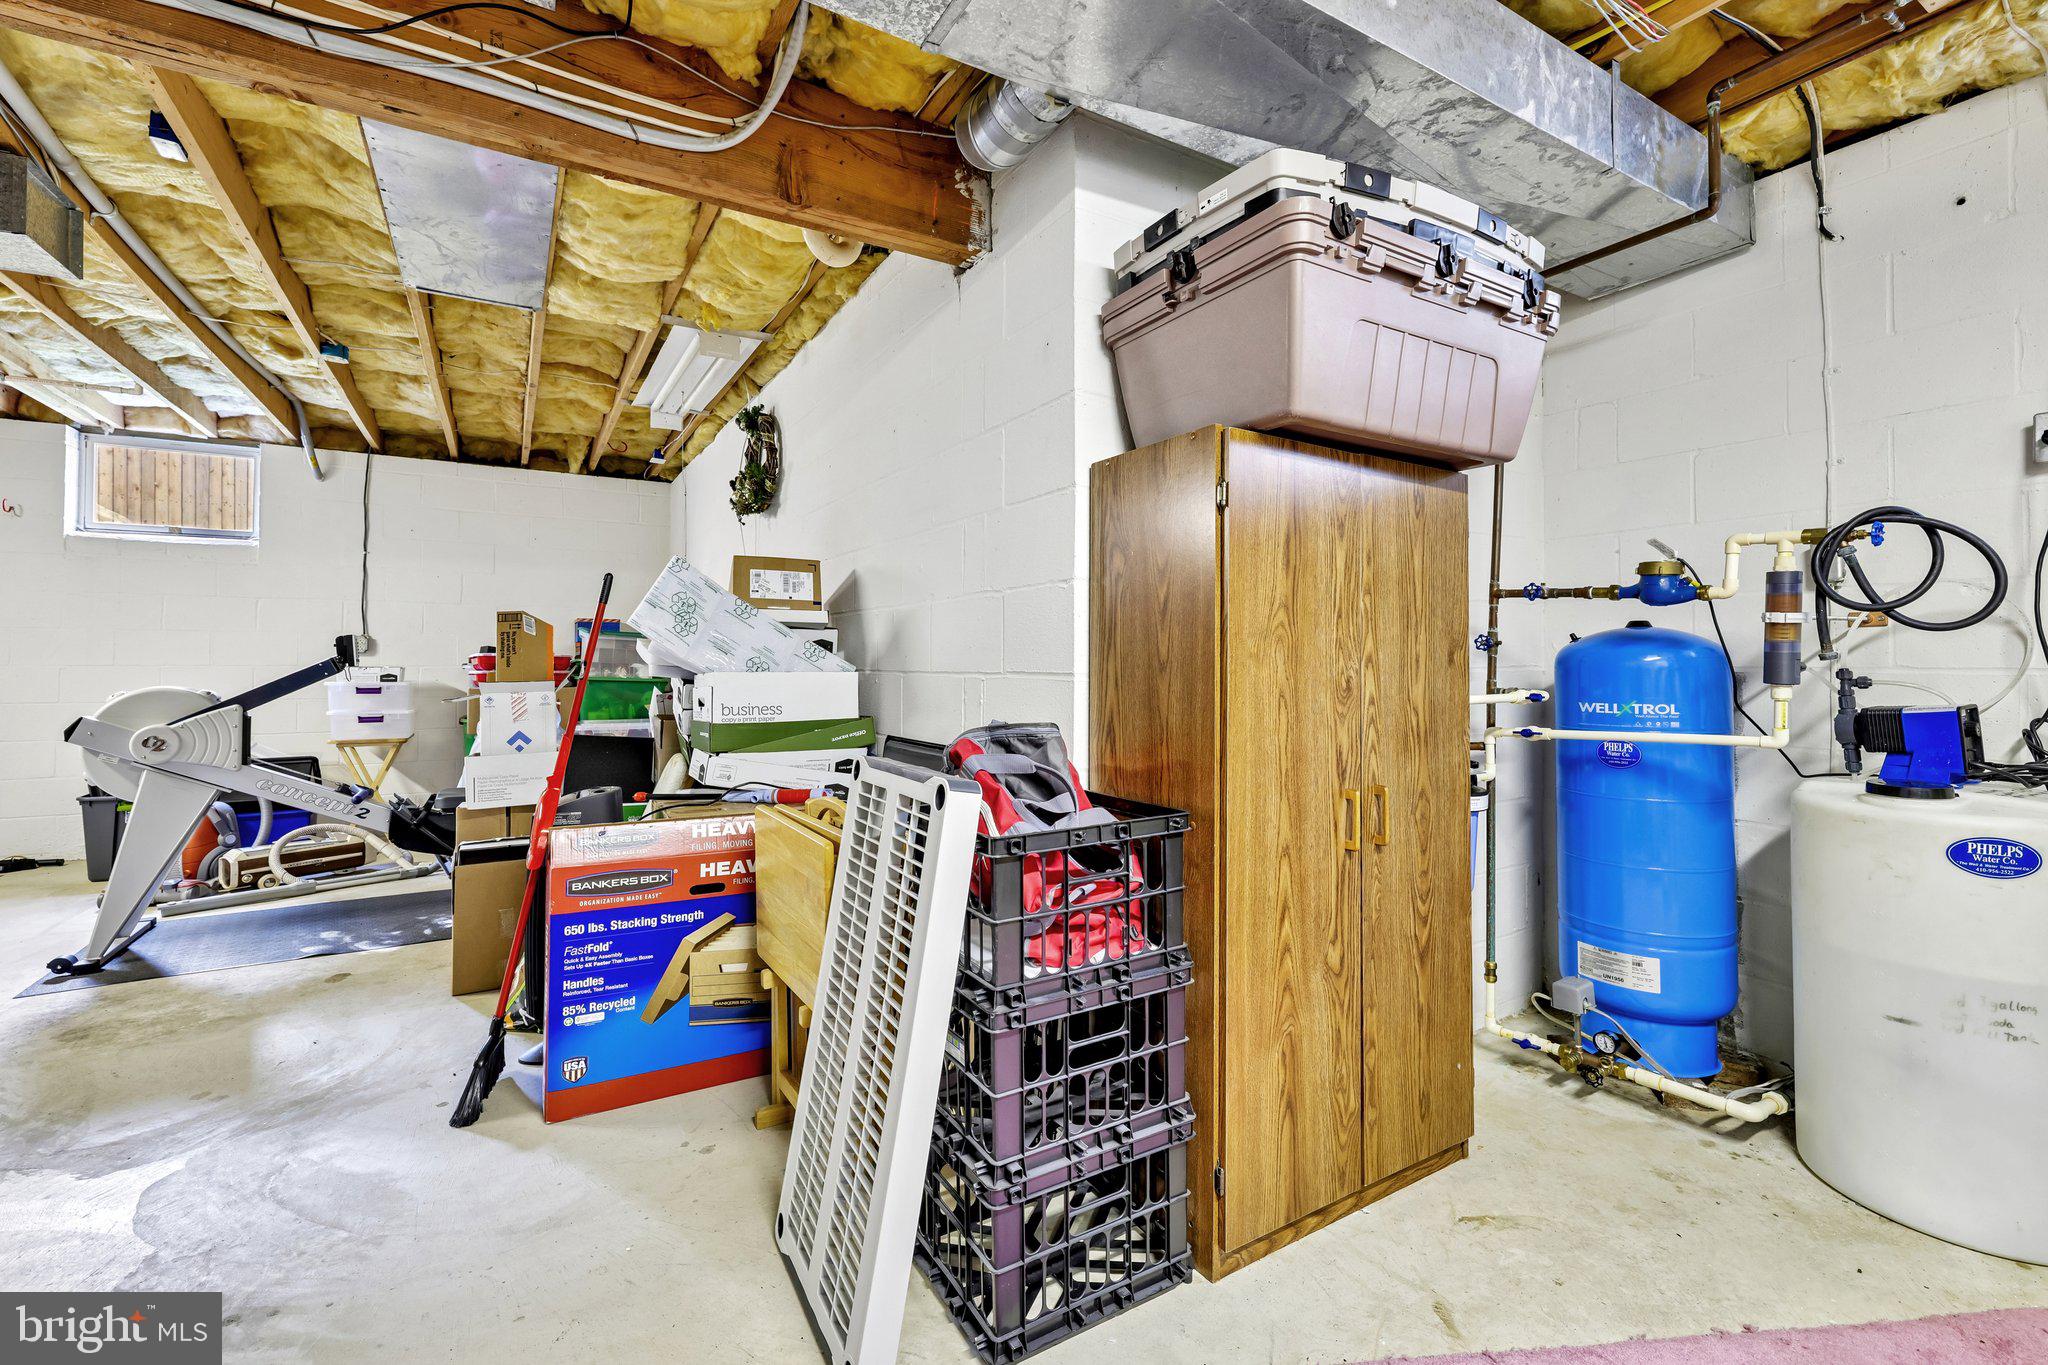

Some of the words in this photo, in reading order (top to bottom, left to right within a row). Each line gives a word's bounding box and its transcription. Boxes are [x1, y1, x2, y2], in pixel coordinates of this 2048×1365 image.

[721, 703, 782, 716] business
[1603, 741, 1633, 752] PHELPS
[256, 780, 356, 815] concept
[355, 808, 370, 819] 2
[634, 833, 656, 842] BOX
[722, 839, 753, 848] MOVING
[1967, 842, 2024, 858] PHELPS
[1972, 854, 2000, 863] Water
[2003, 856, 2018, 865] Co.
[572, 877, 638, 891] BANKERS
[640, 874, 668, 884] BOX
[579, 897, 624, 907] ORGANIZATION
[564, 924, 585, 936] 650
[588, 923, 607, 933] lbs.
[610, 917, 658, 930] Stacking
[661, 910, 704, 924] Strength
[563, 977, 604, 990] Handles
[563, 1004, 586, 1016] 85%
[589, 996, 636, 1012] Recycled
[616, 1005, 635, 1013] Content
[2004, 1032, 2040, 1045] Tan
[564, 1060, 586, 1071] USA
